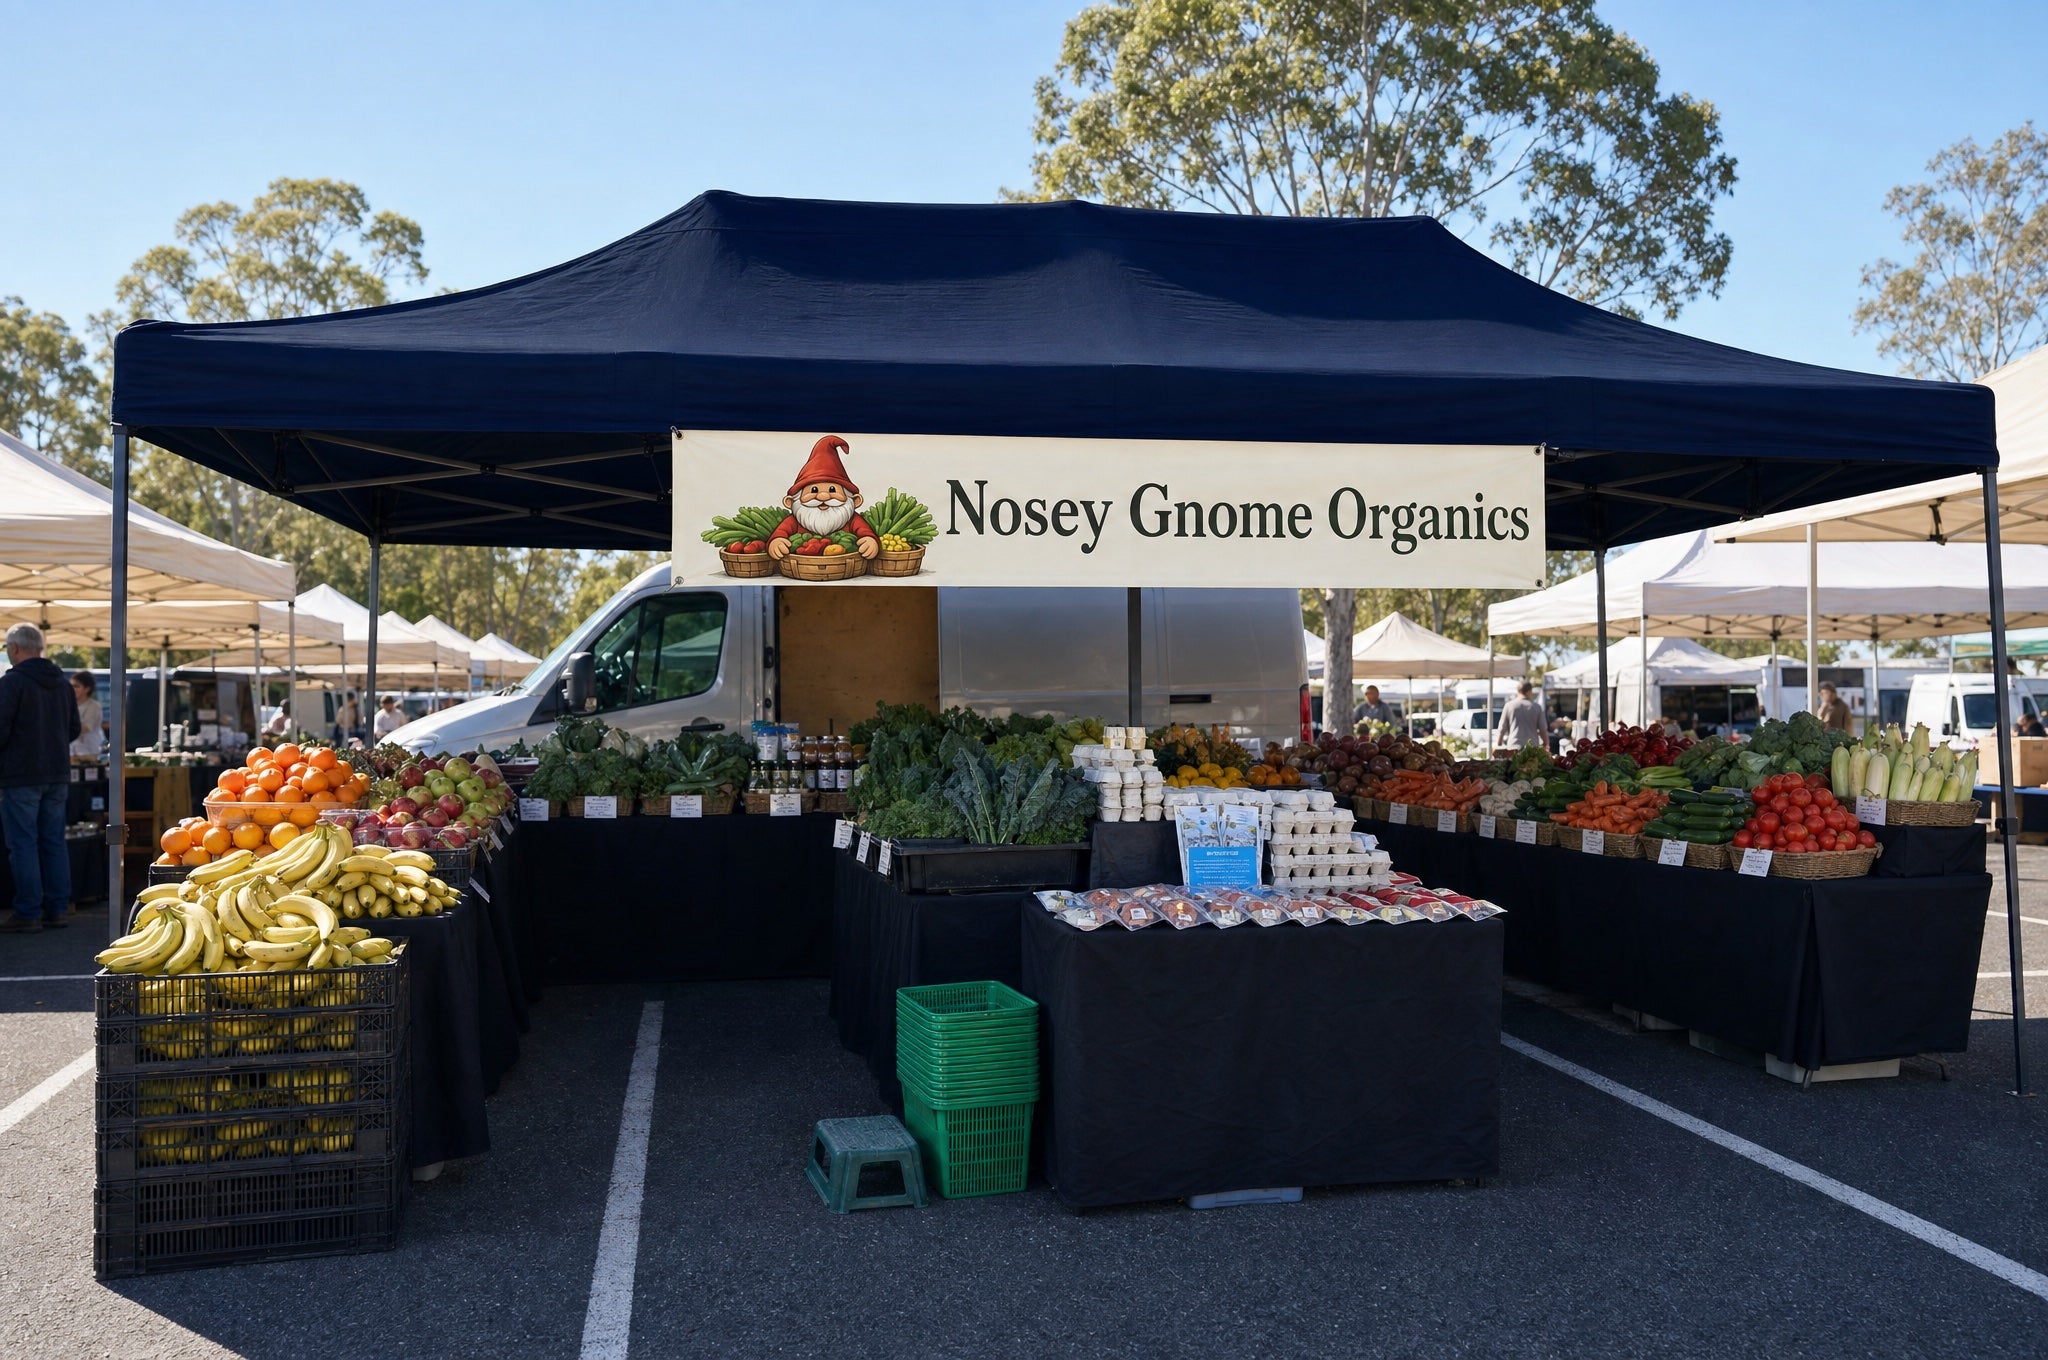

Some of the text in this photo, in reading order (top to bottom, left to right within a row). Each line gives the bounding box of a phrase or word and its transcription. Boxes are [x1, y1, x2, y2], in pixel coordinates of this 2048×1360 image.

[945, 479, 1530, 556] Nosey Gnome Organics
